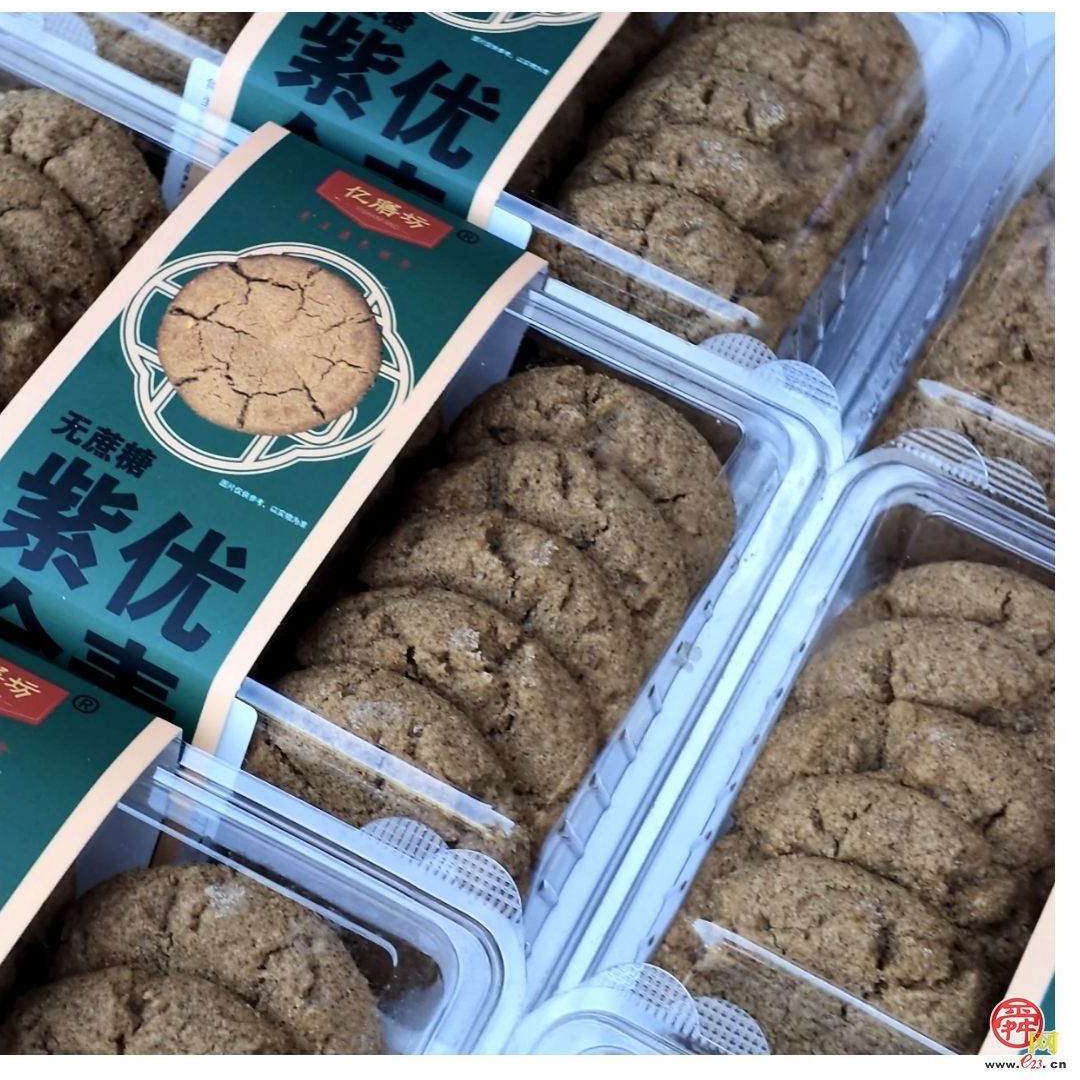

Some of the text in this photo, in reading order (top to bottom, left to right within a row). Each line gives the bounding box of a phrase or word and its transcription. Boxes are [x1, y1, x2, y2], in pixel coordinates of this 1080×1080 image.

[274, 12, 500, 170] 紫优
[50, 410, 157, 479] 无蔗糖
